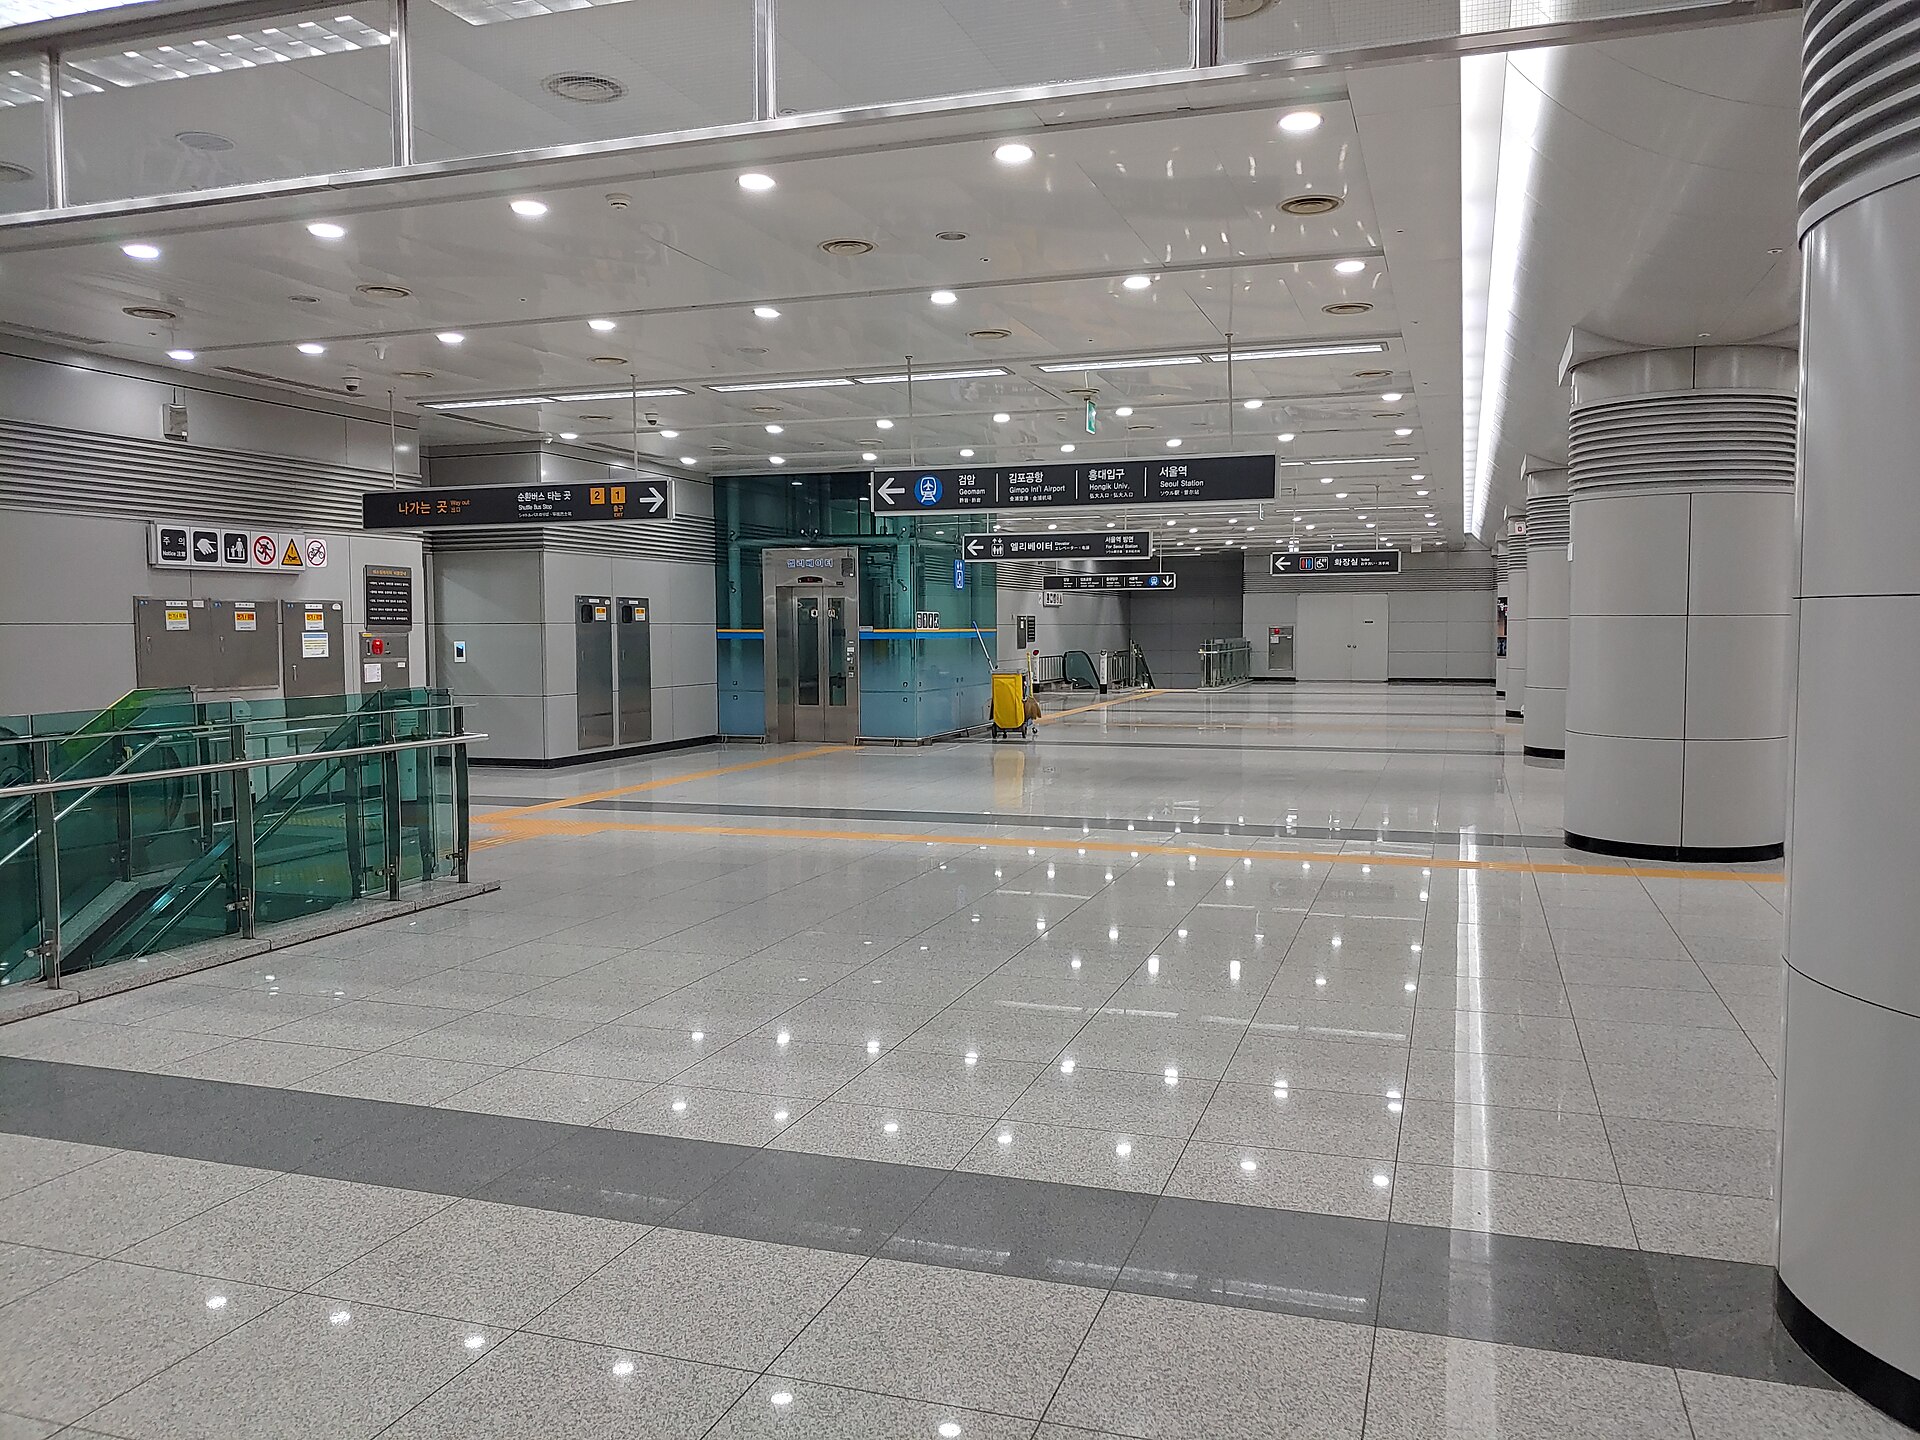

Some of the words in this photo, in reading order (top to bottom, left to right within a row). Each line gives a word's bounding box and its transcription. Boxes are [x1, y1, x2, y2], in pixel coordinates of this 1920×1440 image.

[1088, 468, 1125, 481] 홍대입구
[1159, 465, 1188, 477] 서울역
[959, 474, 976, 486] 검암
[1009, 471, 1044, 484] 김포공항
[1089, 483, 1111, 491] Hongik
[1113, 482, 1130, 490] Univ.
[1160, 480, 1179, 488] Seoul
[1180, 479, 1204, 487] Station
[959, 488, 986, 496] Geomam
[1009, 486, 1029, 494] Gimpo
[1043, 484, 1066, 493] Airport
[518, 491, 545, 502] 순환버스
[547, 490, 562, 501] 타는
[563, 490, 572, 501] 곳
[398, 501, 431, 515] 나가는
[436, 500, 448, 514] 곳
[542, 503, 553, 511] Stop
[1010, 541, 1053, 551] 엘리베이터
[787, 558, 834, 568] 엘리베이터
[1334, 558, 1358, 567] 화장실
